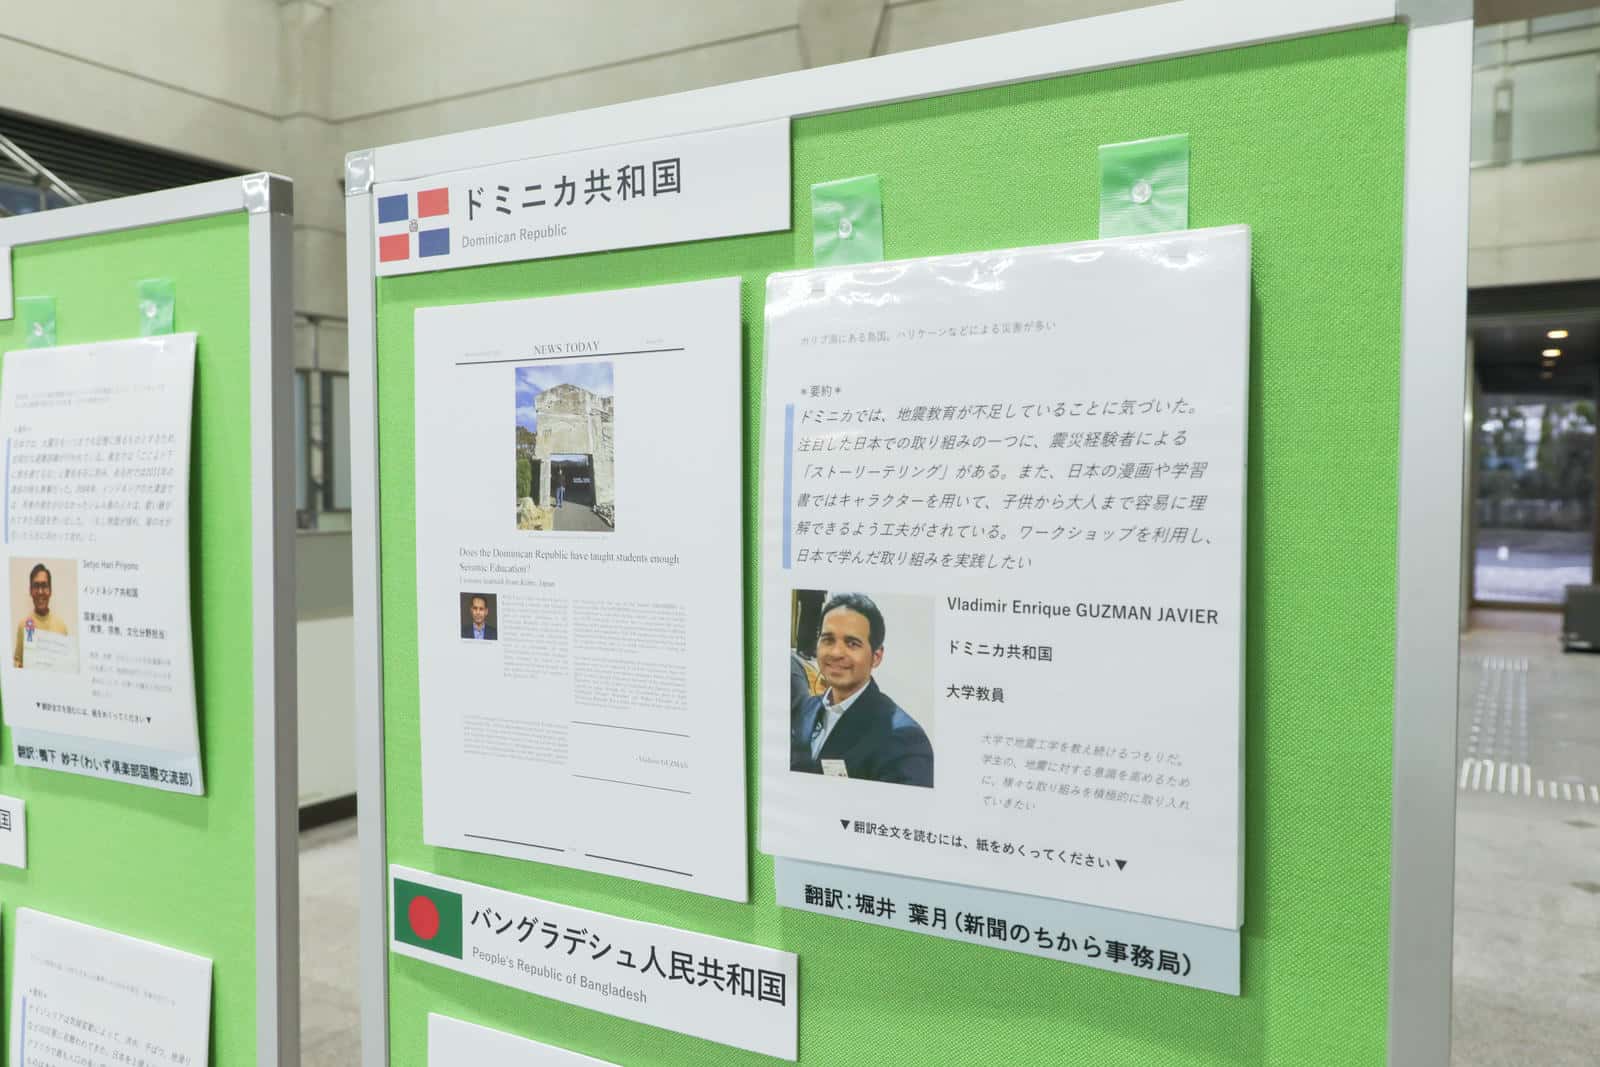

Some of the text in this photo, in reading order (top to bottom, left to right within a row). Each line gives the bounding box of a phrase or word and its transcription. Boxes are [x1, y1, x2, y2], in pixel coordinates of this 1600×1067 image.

[466, 156, 682, 221] ドミニカ共和国
[461, 223, 568, 249] Dominican Republic
[533, 340, 600, 356] NEWS TODAY
[801, 397, 1196, 424] ドミニカでは、地震教育が不足していることに気づいた。
[798, 429, 1188, 452] 注目した日本での取り組みの一つに、震災経験者による
[804, 460, 1209, 481] 「ストーリーテリング」がある。また、日本の漫画や学習
[797, 492, 1209, 512] 書ではキャラクターを用いて、子供から大人まで容易に理
[796, 520, 1213, 545] 解できるよう工夫がされている。ワークショップを利用し、
[797, 548, 1032, 570] 日本で学んだ取り組みを実践したい
[946, 596, 1219, 625] Vladimir Enrique GUZMAN JAVIER
[949, 639, 1053, 663] ドミニカ共和国
[946, 683, 1005, 704] 大学教員
[853, 820, 1111, 869] 翻訳全文を読むには、紙をめくってください
[804, 883, 1192, 977] 翻訳：堀井 葉月（新聞のちから事務局）
[470, 907, 787, 1007] バングラデシュ人民共和国
[472, 945, 648, 1004] People's Republic of Bangladesh
